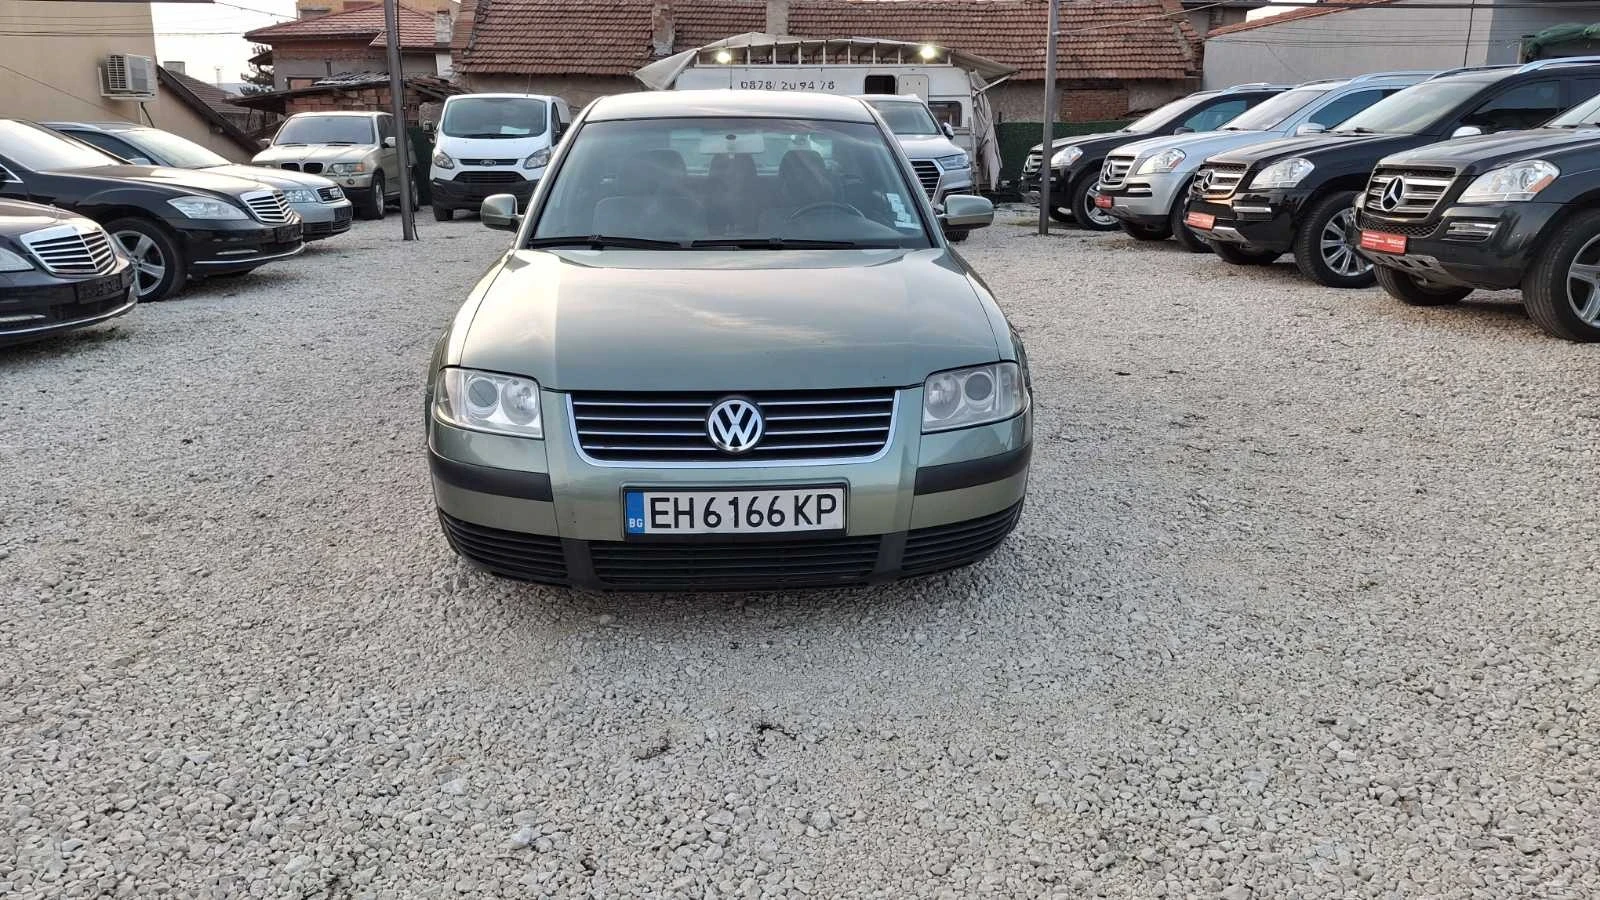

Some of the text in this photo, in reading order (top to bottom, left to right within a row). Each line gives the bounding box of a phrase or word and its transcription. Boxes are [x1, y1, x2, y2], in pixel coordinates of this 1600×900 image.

[650, 493, 837, 529] EH 6166 KP
[628, 518, 643, 528] BG
